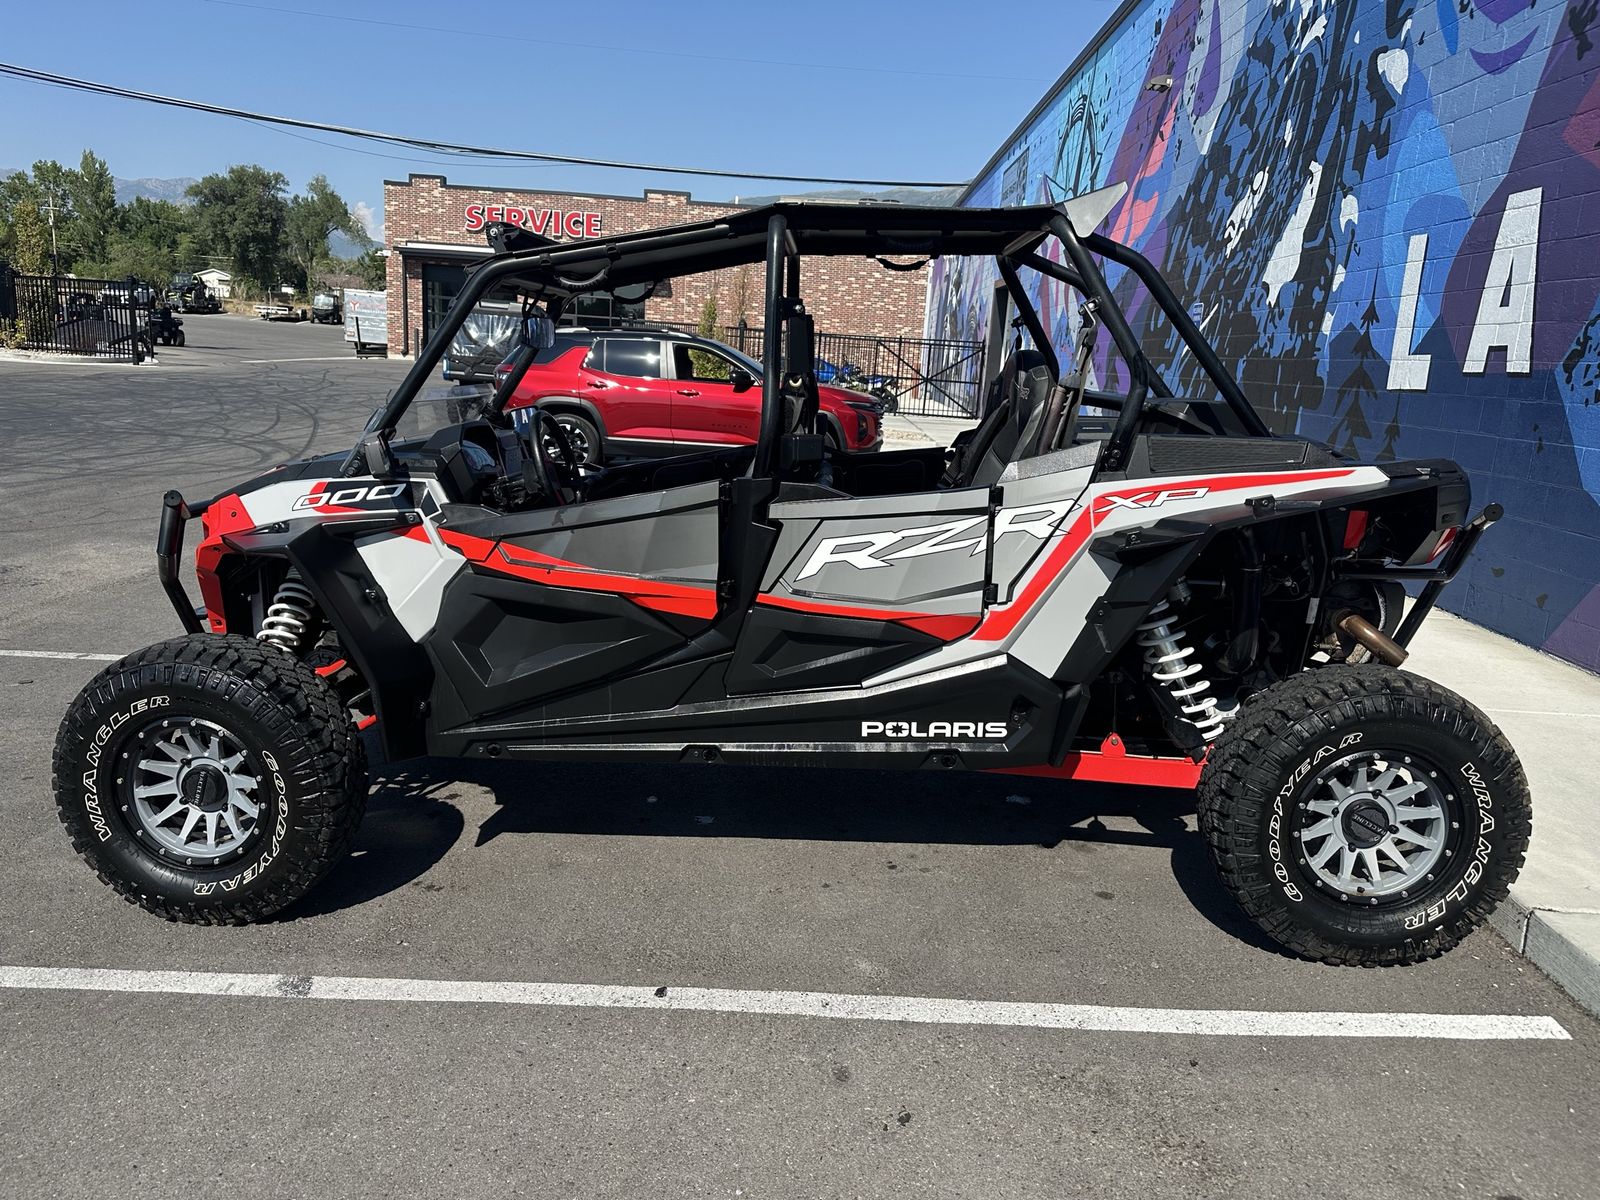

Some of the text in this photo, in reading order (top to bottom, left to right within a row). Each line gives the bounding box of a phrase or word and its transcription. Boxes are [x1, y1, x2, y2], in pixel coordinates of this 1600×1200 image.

[465, 204, 601, 238] SERVICE
[793, 498, 1082, 583] RZR
[1093, 487, 1211, 512] XP
[83, 695, 170, 842] WRANGLER
[861, 721, 1008, 738] POLARIS
[193, 750, 288, 896] GOODYEAR
[1269, 732, 1363, 902] GOODYEAR
[1404, 762, 1495, 930] WRANGLER
